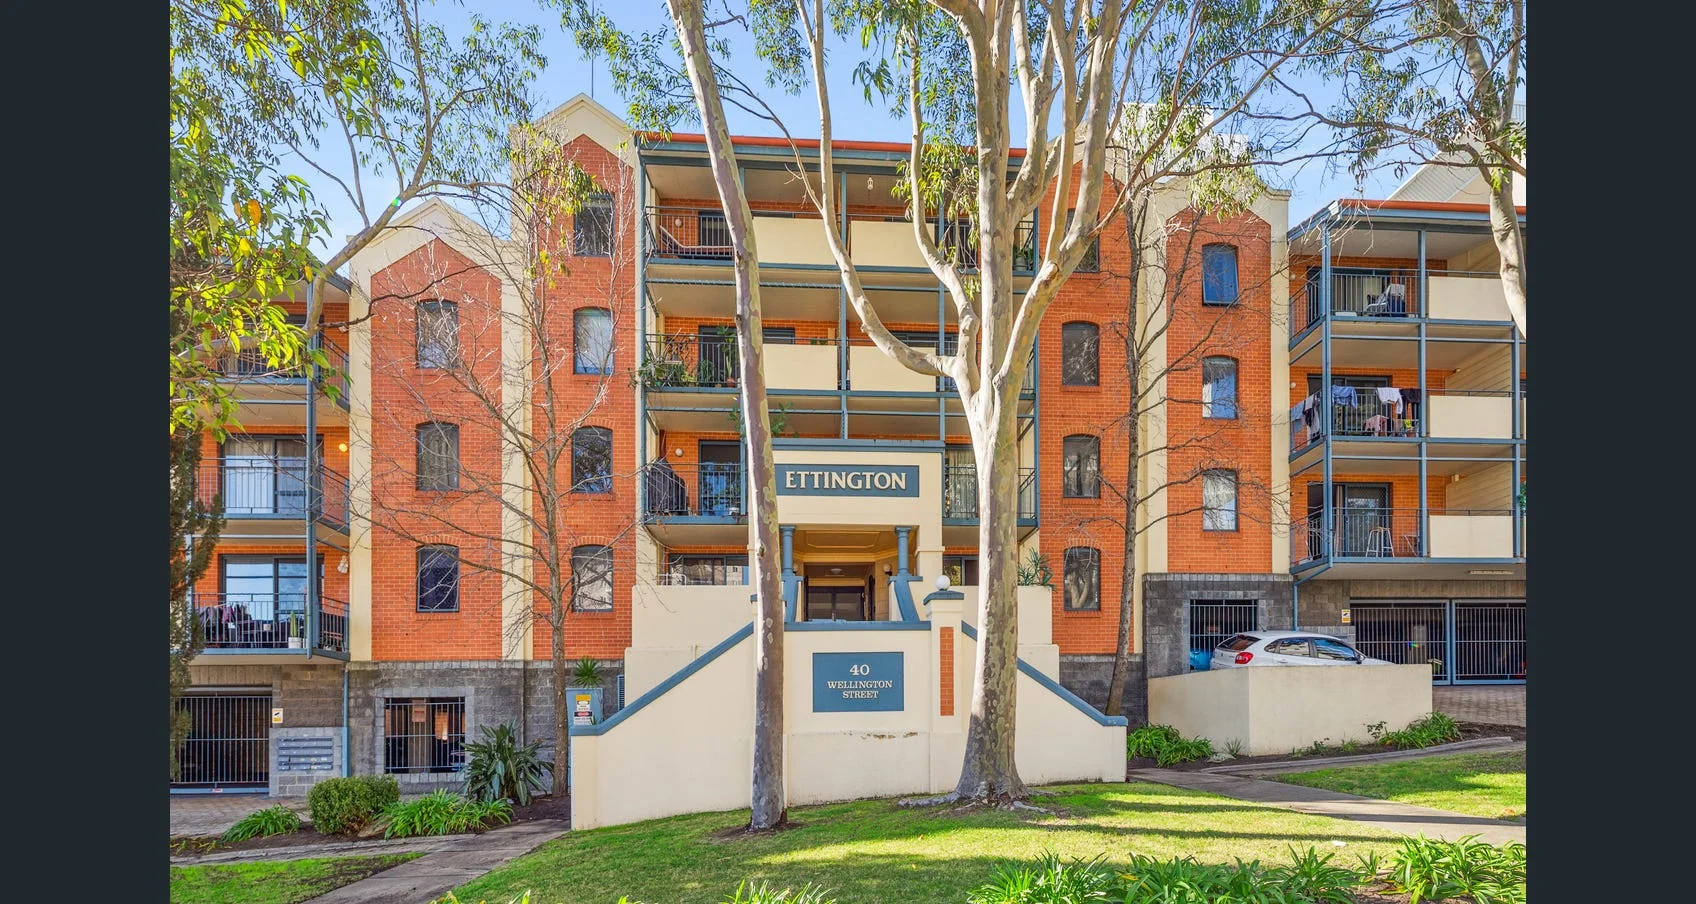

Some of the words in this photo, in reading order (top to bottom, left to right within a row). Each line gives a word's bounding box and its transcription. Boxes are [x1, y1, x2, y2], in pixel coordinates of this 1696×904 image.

[785, 471, 906, 490] ETTINGTON
[849, 664, 870, 676] 40
[827, 680, 893, 689] WELLINGTON
[842, 690, 879, 699] STREET
